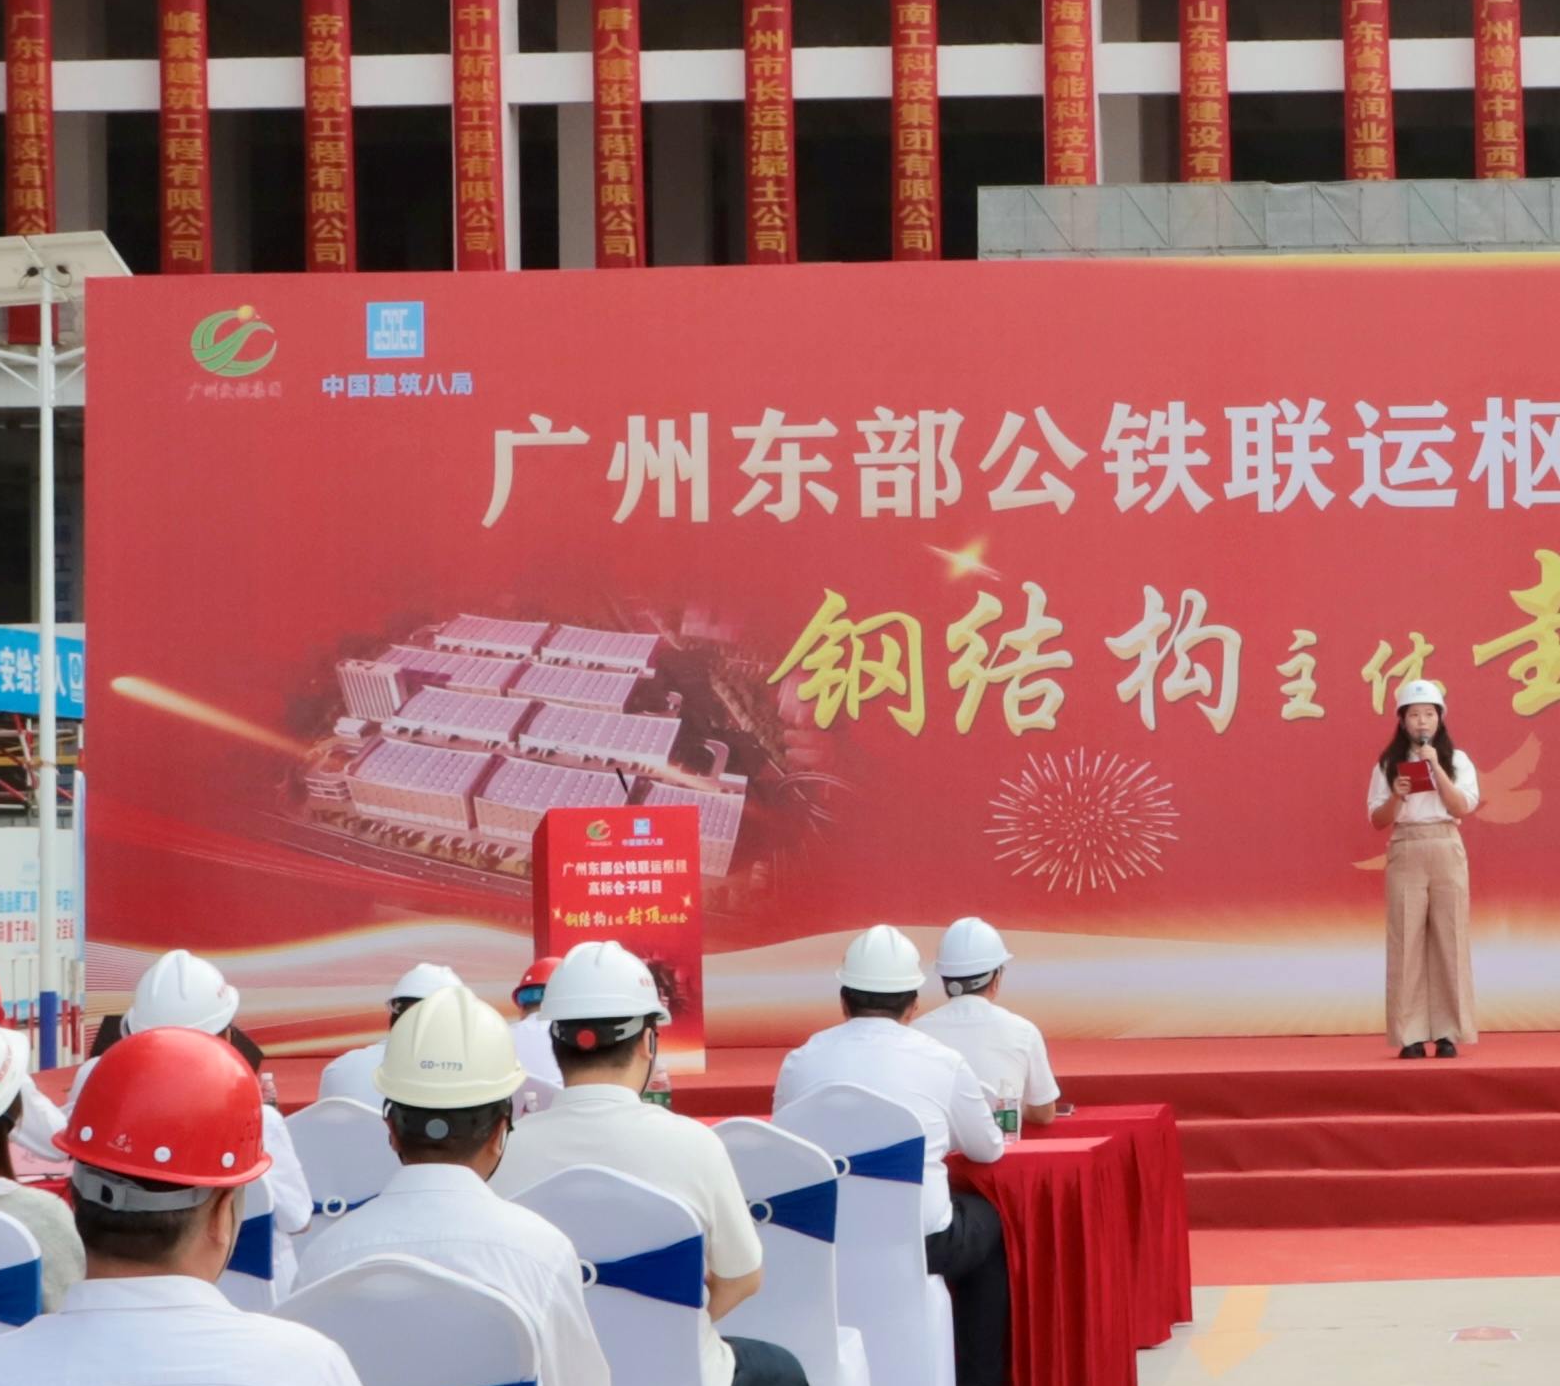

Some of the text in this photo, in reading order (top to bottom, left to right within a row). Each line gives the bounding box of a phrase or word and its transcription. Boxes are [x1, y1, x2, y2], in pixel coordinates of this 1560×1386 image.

[749, 4, 789, 253] 广州市长运混凝土公司
[896, 2, 936, 251] 南工科技集团有限公司
[321, 372, 473, 399] 中国建筑八局
[588, 879, 663, 896] 高标仓子项目
